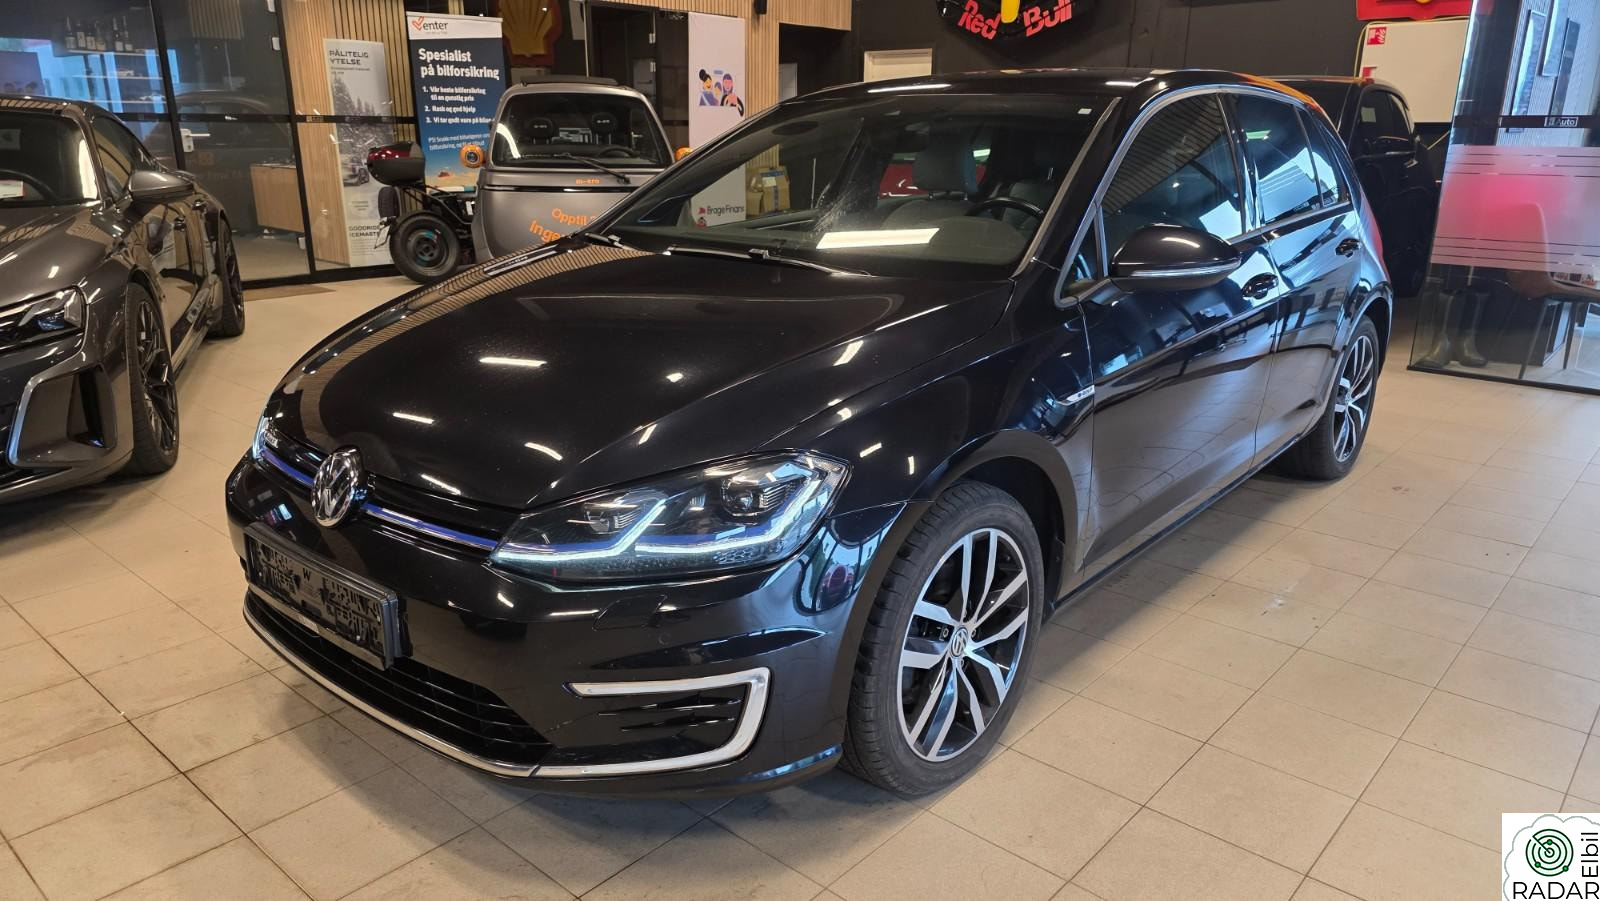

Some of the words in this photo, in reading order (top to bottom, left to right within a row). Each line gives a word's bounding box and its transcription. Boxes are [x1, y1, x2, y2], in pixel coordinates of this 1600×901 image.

[423, 22, 448, 30] enter
[957, 0, 1001, 40] Red
[1023, 0, 1072, 37] Bull
[329, 49, 369, 58] PÅLITELIG
[418, 48, 472, 62] Spesialist
[421, 63, 434, 78] på
[436, 64, 500, 80] bilforsikring
[551, 208, 588, 226] Opptil
[529, 220, 564, 243] Inge
